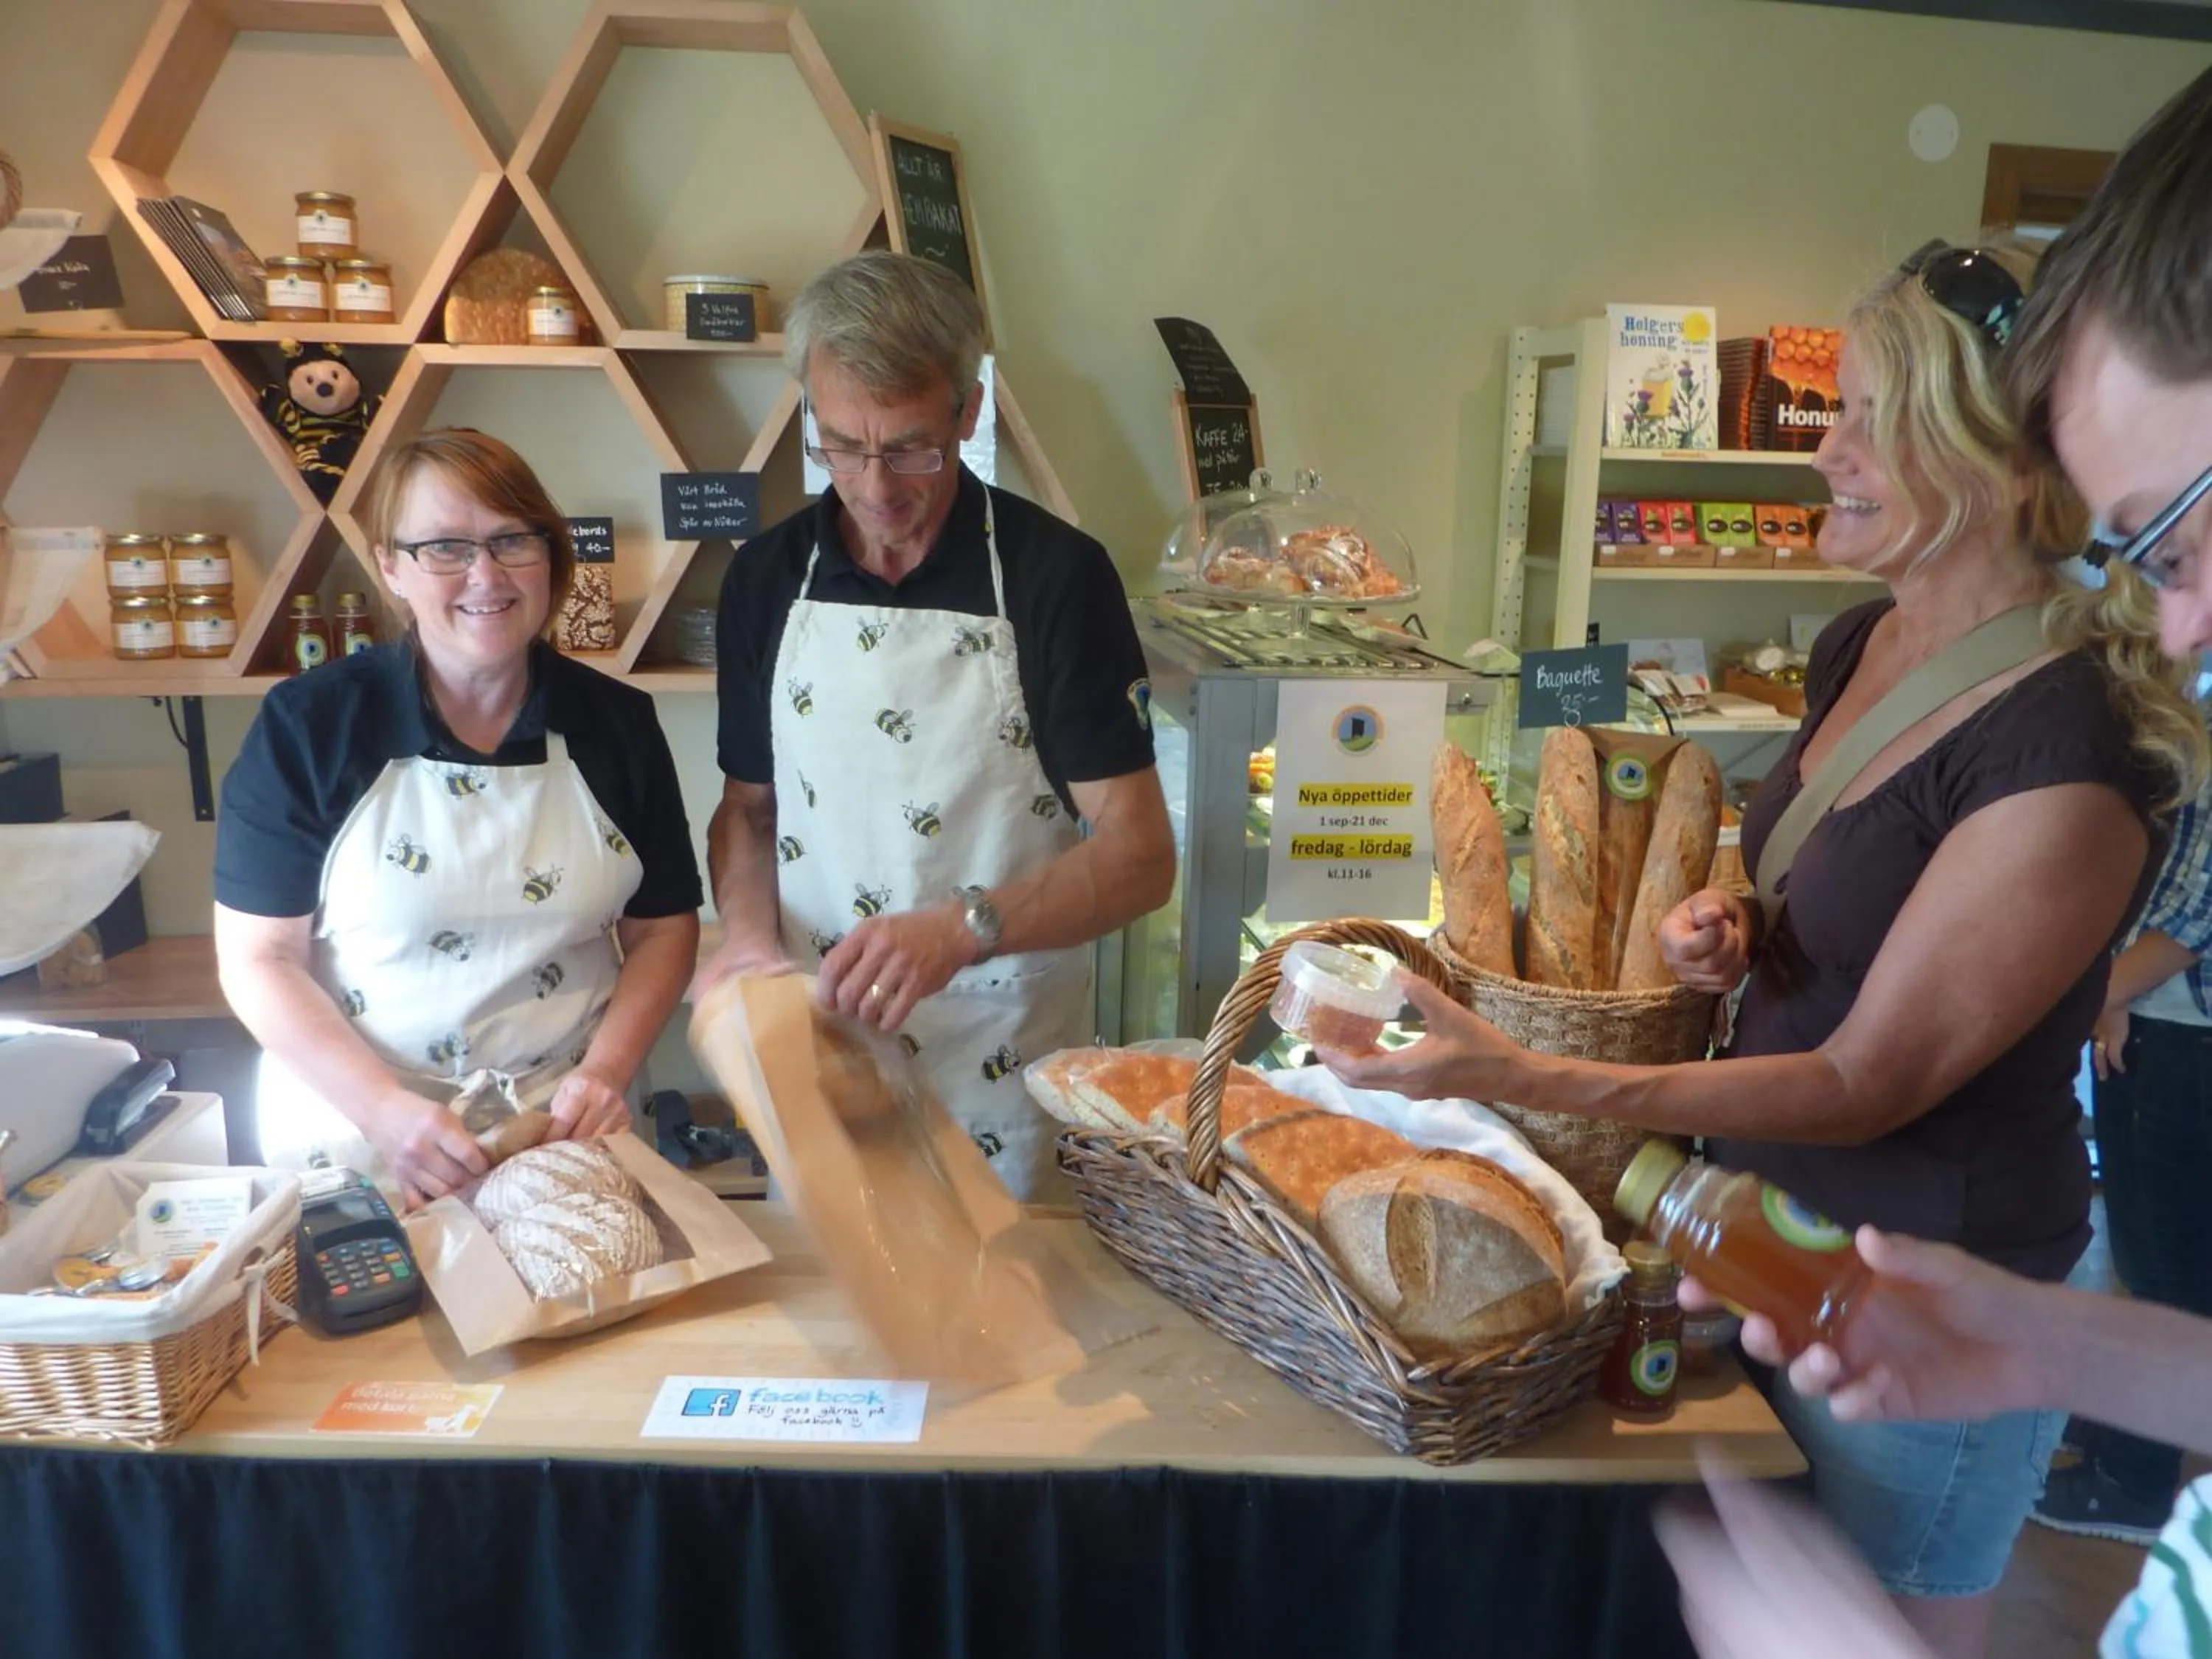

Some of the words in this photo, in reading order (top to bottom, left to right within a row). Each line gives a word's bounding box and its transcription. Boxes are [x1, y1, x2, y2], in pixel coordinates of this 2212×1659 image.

[1624, 316, 1685, 333] Holgers
[1620, 332, 1678, 351] honung
[1778, 403, 1839, 427] Honu
[1195, 423, 1228, 446] KAFFE
[1536, 664, 1604, 697] Baguette
[1298, 789, 1328, 806] Nya
[1332, 787, 1413, 806] öppettider
[1320, 815, 1326, 827] 1
[1329, 815, 1365, 828] sep-21
[1368, 815, 1388, 827] dec
[1291, 839, 1345, 858] fredag
[1360, 838, 1413, 858] lördag
[1328, 868, 1372, 880] kl.11-16
[748, 1387, 884, 1405] facebook
